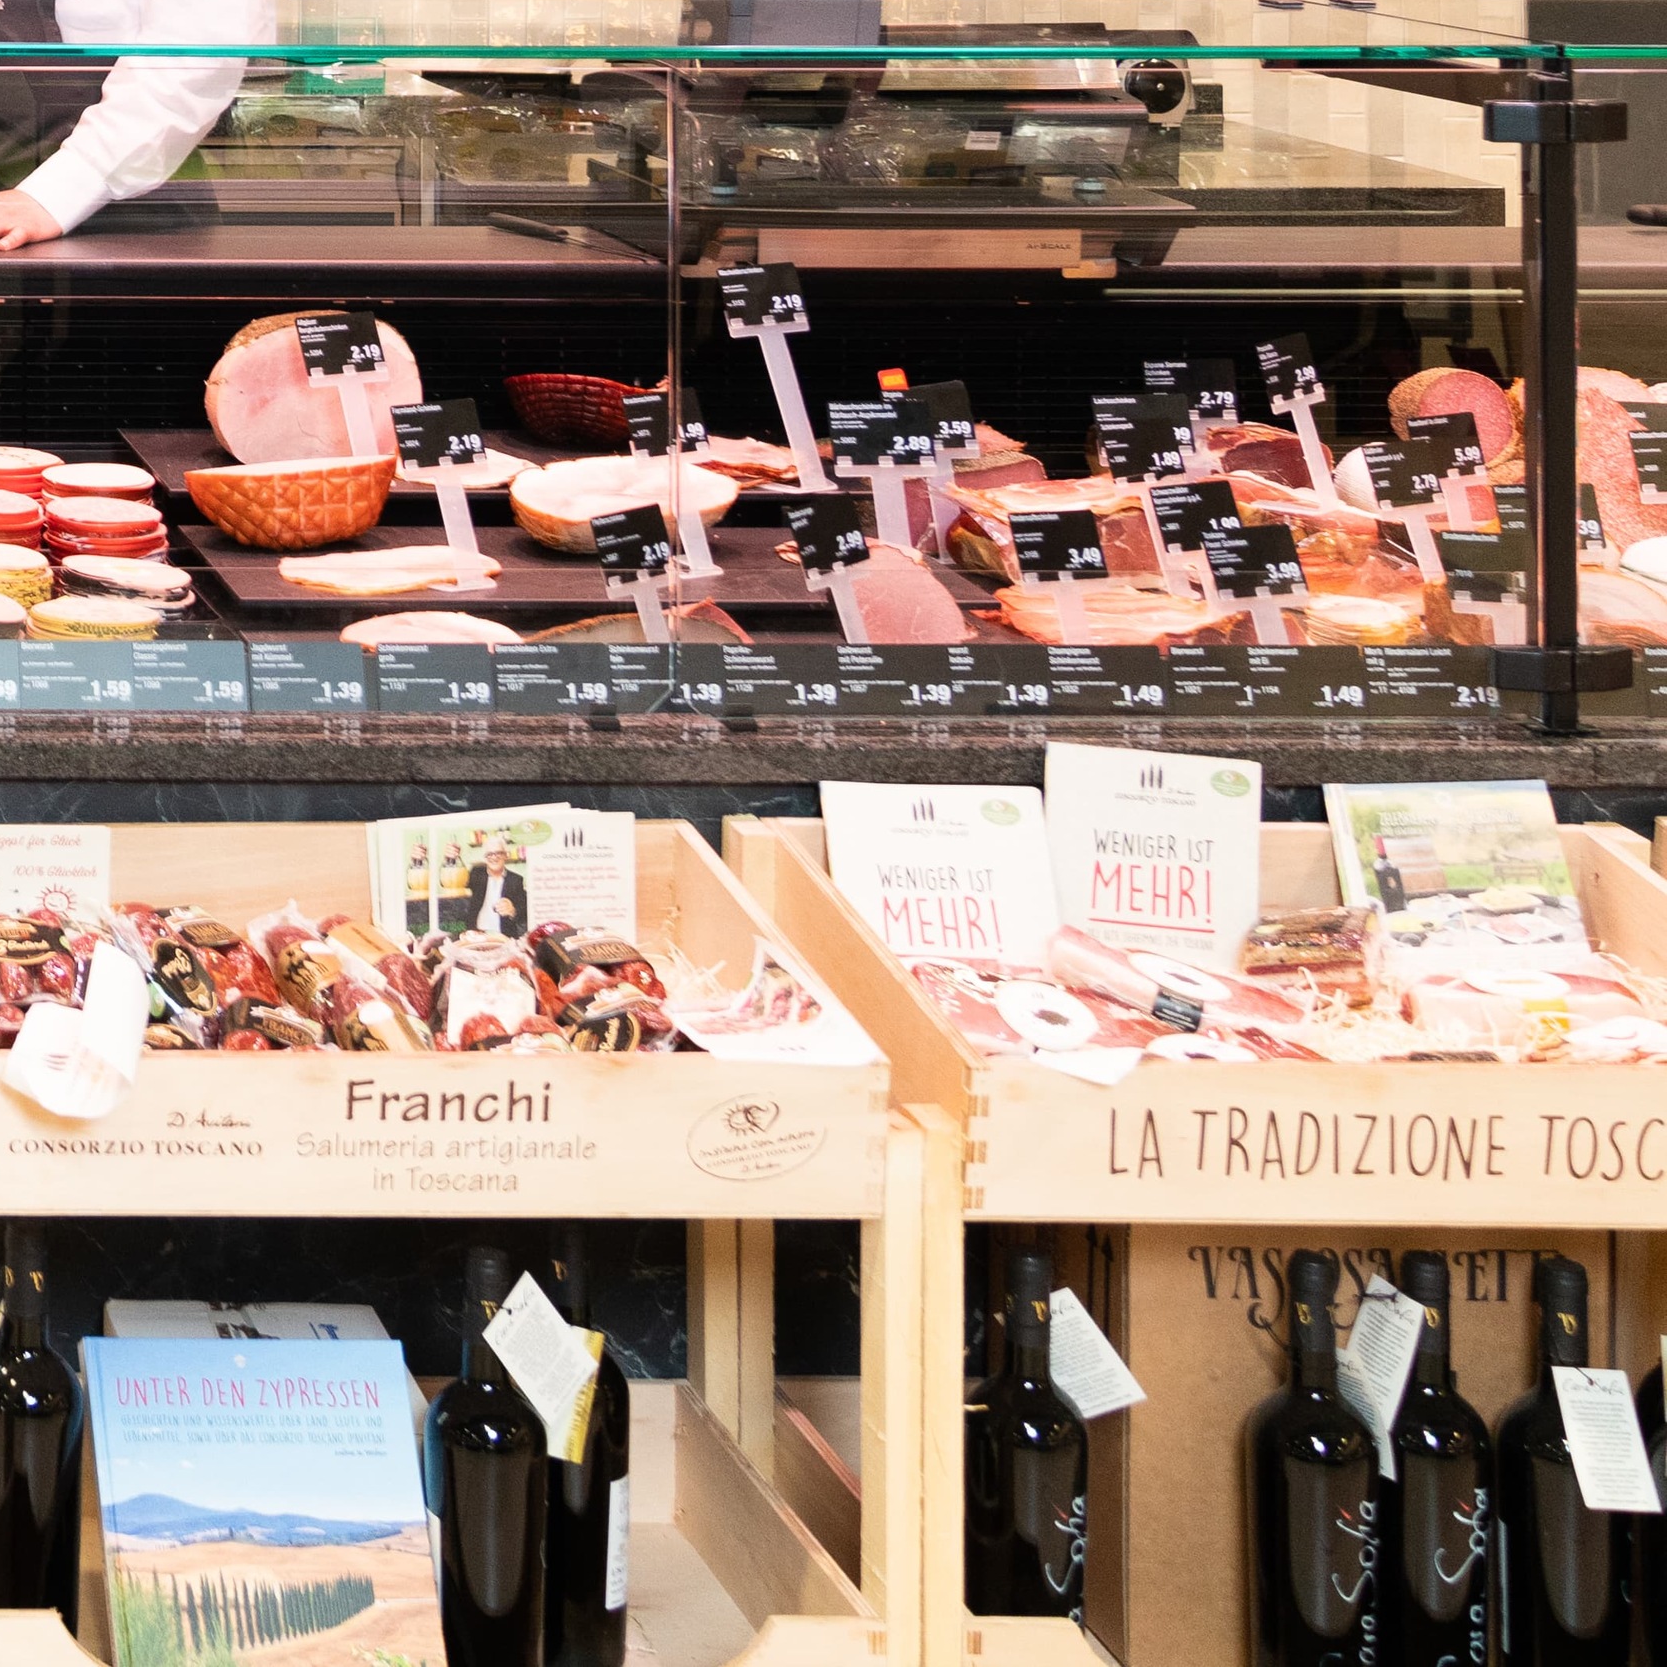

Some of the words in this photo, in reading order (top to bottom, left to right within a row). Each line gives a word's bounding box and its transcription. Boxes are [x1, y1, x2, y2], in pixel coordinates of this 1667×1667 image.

[771, 294, 802, 309] 2.19
[351, 344, 380, 360] 2.19
[1295, 365, 1316, 382] 2.99
[1200, 392, 1234, 405] 2.79
[939, 421, 971, 435] 3.59
[449, 434, 481, 451] 2.19
[893, 436, 931, 450] 2.89
[1151, 451, 1180, 467] 1.89
[1454, 446, 1481, 461] 5.99
[1411, 474, 1438, 490] 2.79
[836, 530, 862, 551] 2.99
[1068, 547, 1102, 564] 3.49
[1266, 562, 1301, 582] 3.99
[91, 680, 131, 698] 1.59
[203, 681, 244, 698] 1.59
[321, 681, 362, 699] 1.39
[449, 682, 490, 699] 1.39
[567, 682, 608, 699] 1.59
[681, 683, 722, 700] 1.39
[795, 683, 837, 701] 1.39
[909, 684, 951, 701] 1.39
[1006, 685, 1048, 702] 1.39
[1120, 685, 1163, 702] 1.49
[1321, 686, 1363, 703] 1.49
[1457, 686, 1499, 703] 2.19
[1094, 829, 1177, 860] WENIGER
[1188, 839, 1215, 863] IST
[877, 864, 960, 891] WENIGER
[968, 869, 993, 892] IST
[1090, 861, 1215, 924] MEHR!
[882, 896, 1003, 953] MEHR!
[346, 1079, 552, 1123] Franchi
[9, 1139, 145, 1156] CONSORZIO
[152, 1139, 263, 1156] TOSCANO
[296, 1133, 433, 1159] Salumeria
[445, 1134, 597, 1165] artigianale
[1109, 1107, 1164, 1176] LA
[1194, 1109, 1505, 1179] TRADIZIONE
[373, 1168, 395, 1191] in
[404, 1167, 519, 1193] Toscana
[116, 1377, 190, 1406] UNTER
[202, 1378, 245, 1407] DEN
[256, 1378, 380, 1408] ZYPRESSEN
